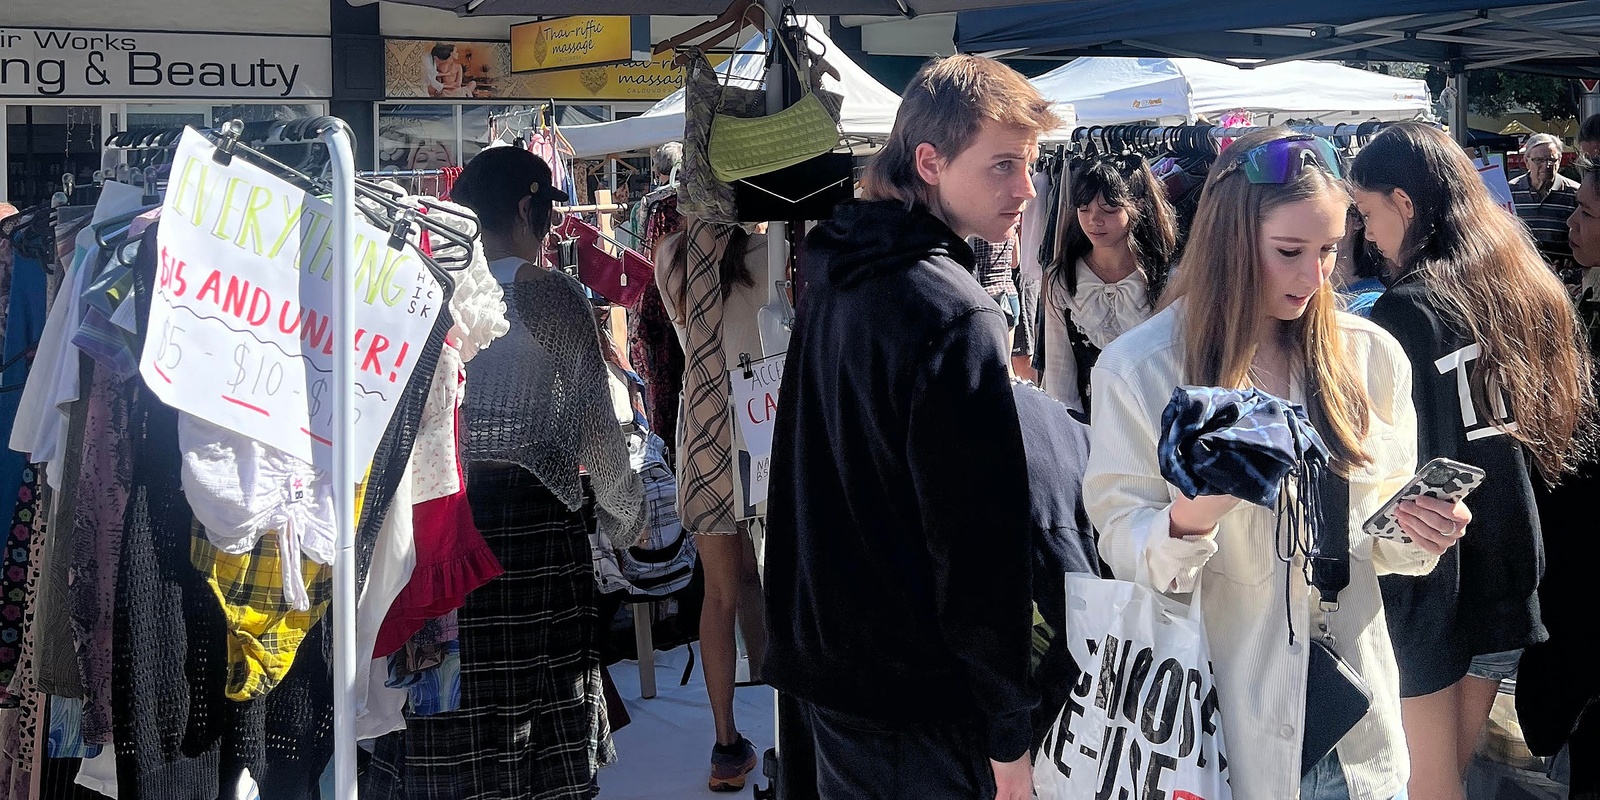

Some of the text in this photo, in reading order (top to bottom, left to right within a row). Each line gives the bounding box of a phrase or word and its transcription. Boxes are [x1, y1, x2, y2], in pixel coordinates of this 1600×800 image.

[34, 31, 137, 51] Works
[543, 19, 604, 40] Thai-riffic
[552, 39, 595, 55] massage
[85, 51, 111, 86] &
[128, 51, 300, 96] Beauty
[160, 246, 410, 384] $15 AND UNR!
[226, 341, 285, 397] $10
[751, 360, 786, 391] ACCE
[747, 388, 782, 425] CA
